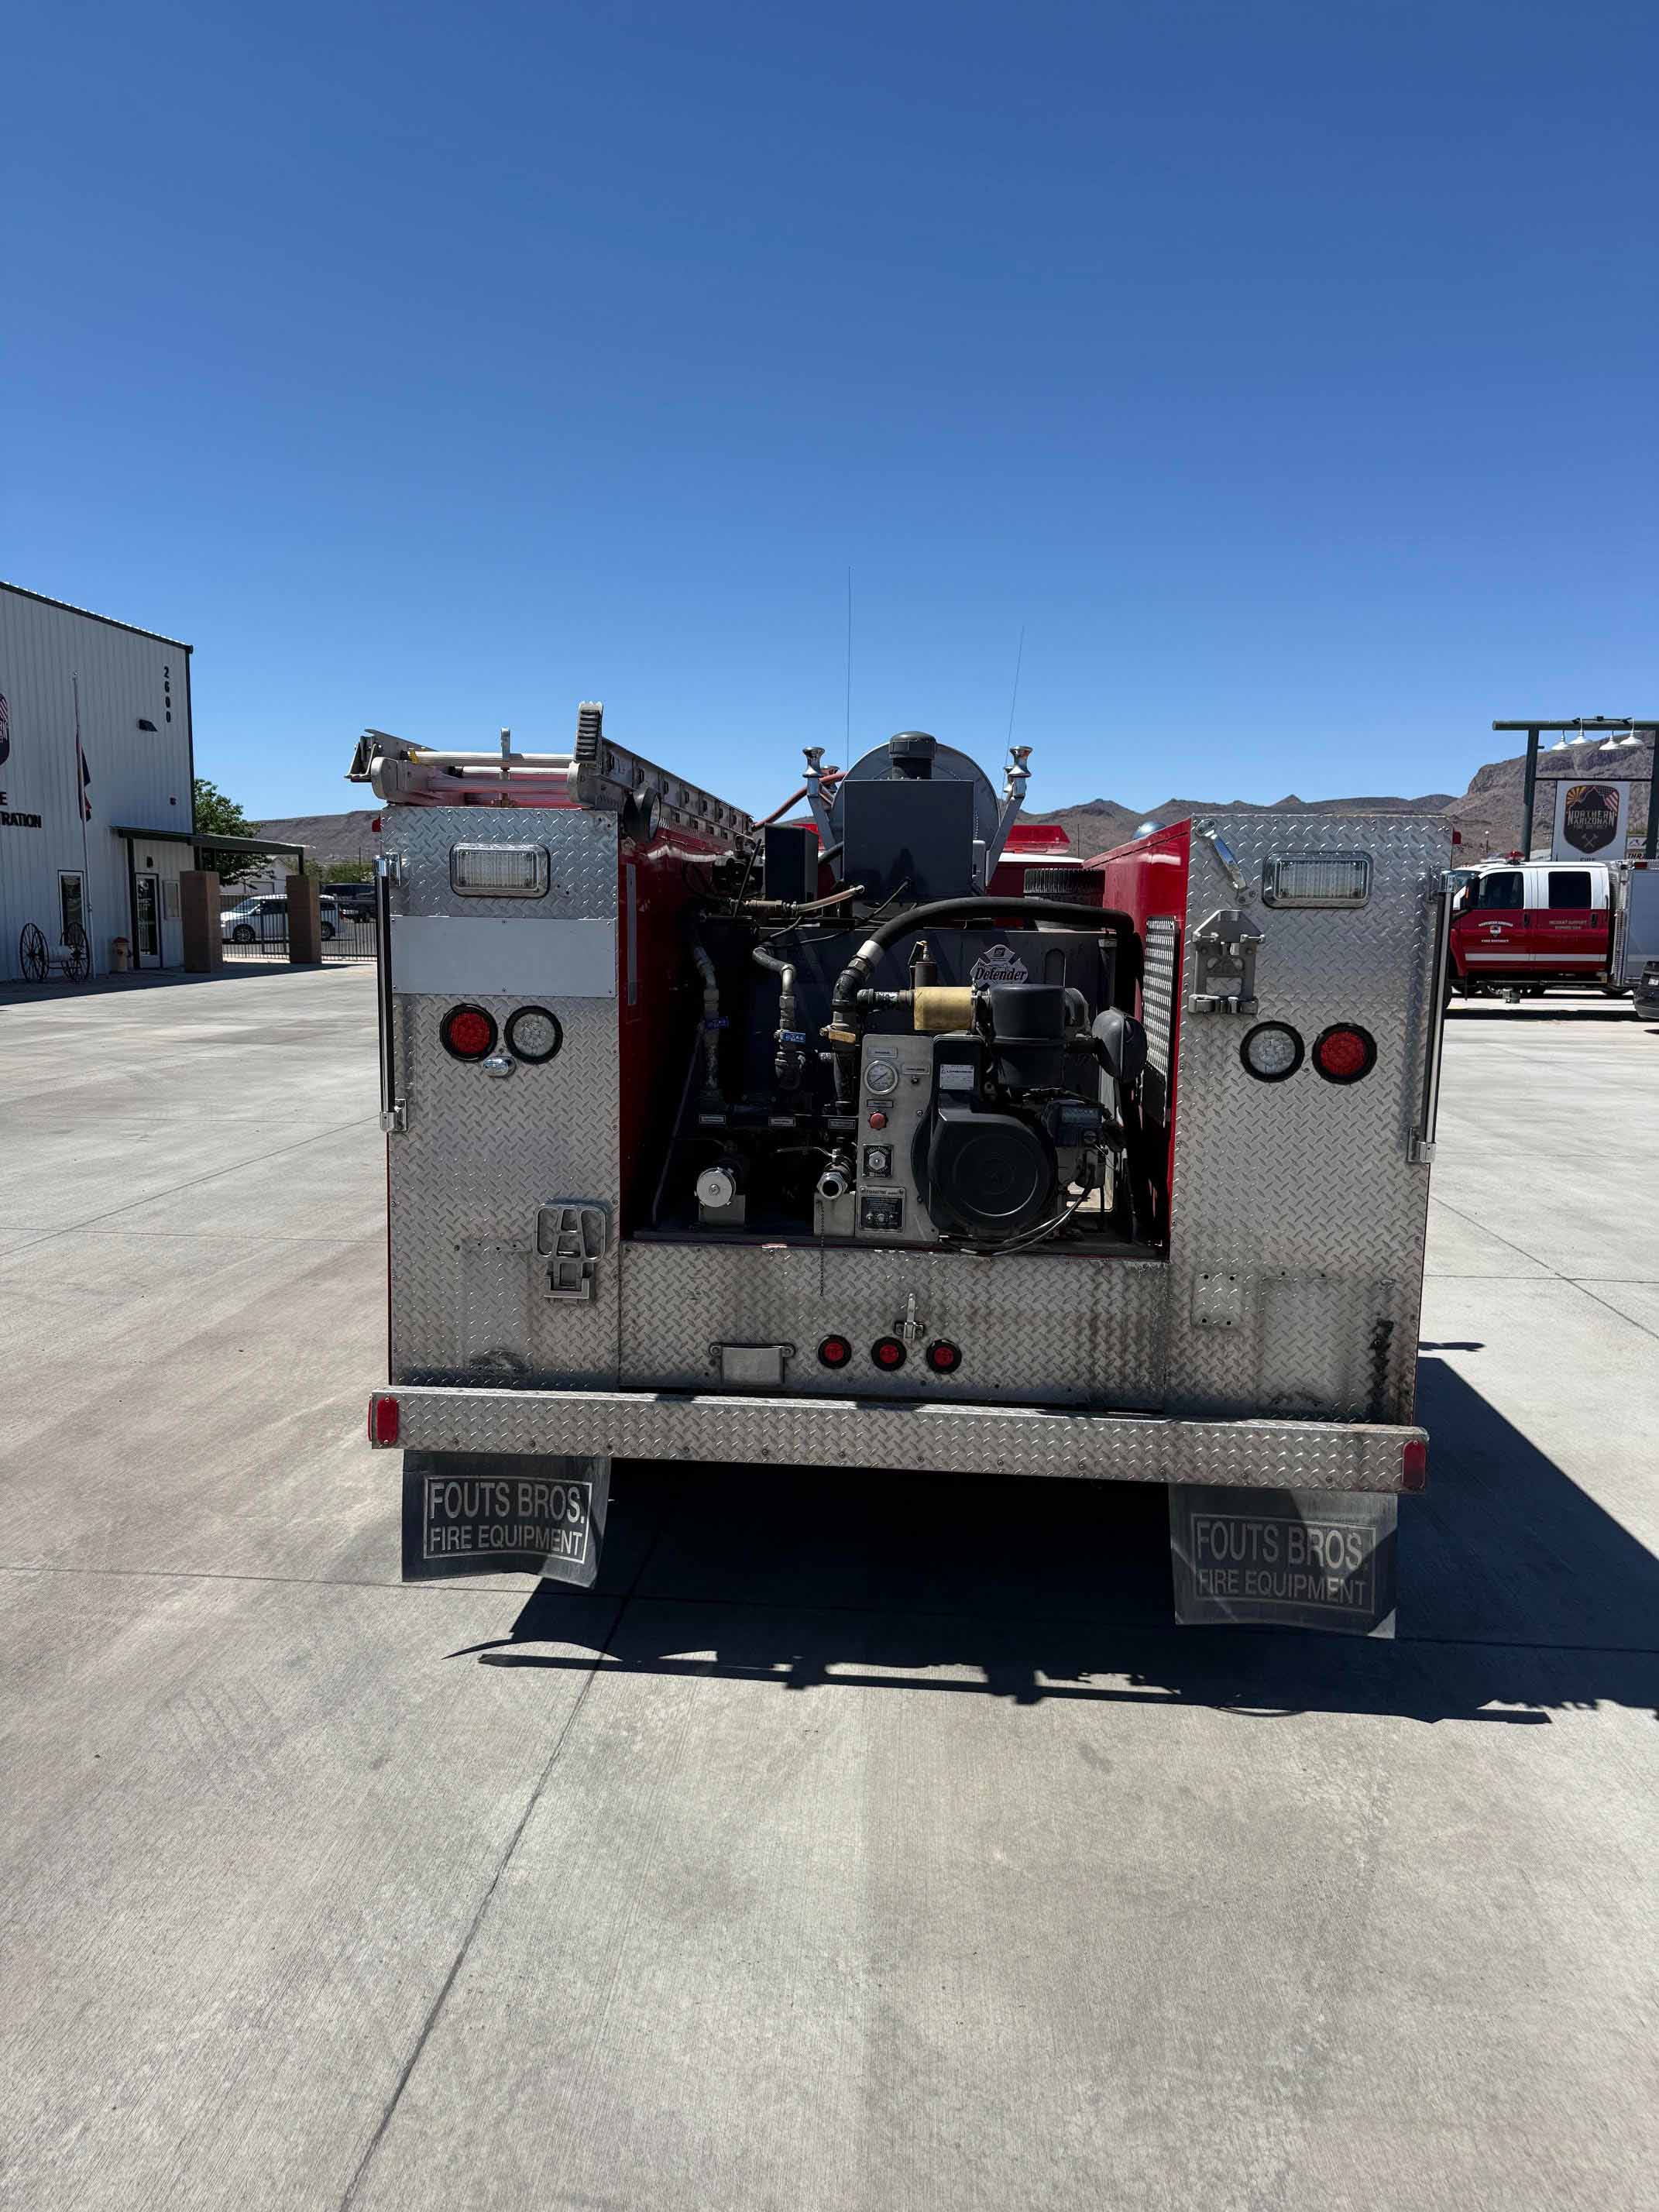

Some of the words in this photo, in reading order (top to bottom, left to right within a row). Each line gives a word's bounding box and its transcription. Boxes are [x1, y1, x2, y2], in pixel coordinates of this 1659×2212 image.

[1568, 810, 1615, 827] NORTHERN
[976, 967, 1026, 980] Defender
[430, 1482, 510, 1519] FOUTS
[518, 1482, 585, 1523] BROS.
[430, 1526, 472, 1551] FIRE
[478, 1525, 582, 1555] EQUIPMENT
[1197, 1521, 1279, 1562] FOUTS
[1200, 1569, 1239, 1594] FIRE
[1245, 1570, 1366, 1606] EQUIPMENT
